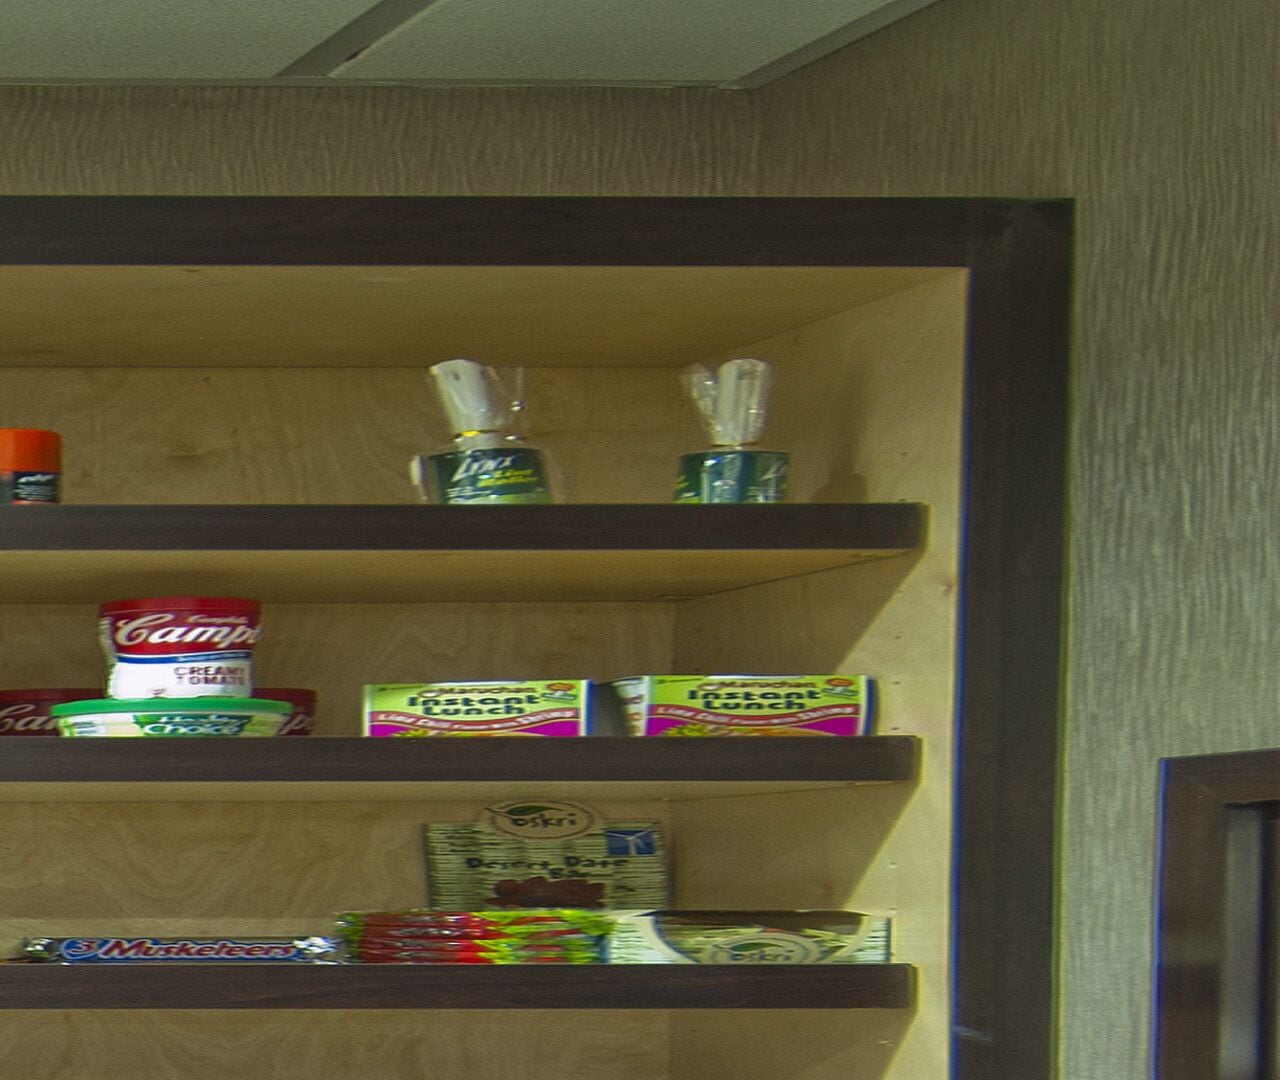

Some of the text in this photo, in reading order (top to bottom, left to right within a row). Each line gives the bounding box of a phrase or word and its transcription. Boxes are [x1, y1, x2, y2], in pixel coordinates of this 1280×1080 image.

[407, 695, 540, 707] Instant
[687, 689, 822, 701] Instant
[422, 705, 525, 716] Lunch
[702, 700, 806, 711] Lunch
[510, 813, 578, 829] oskri
[67, 940, 294, 958] 3 Musketeers
